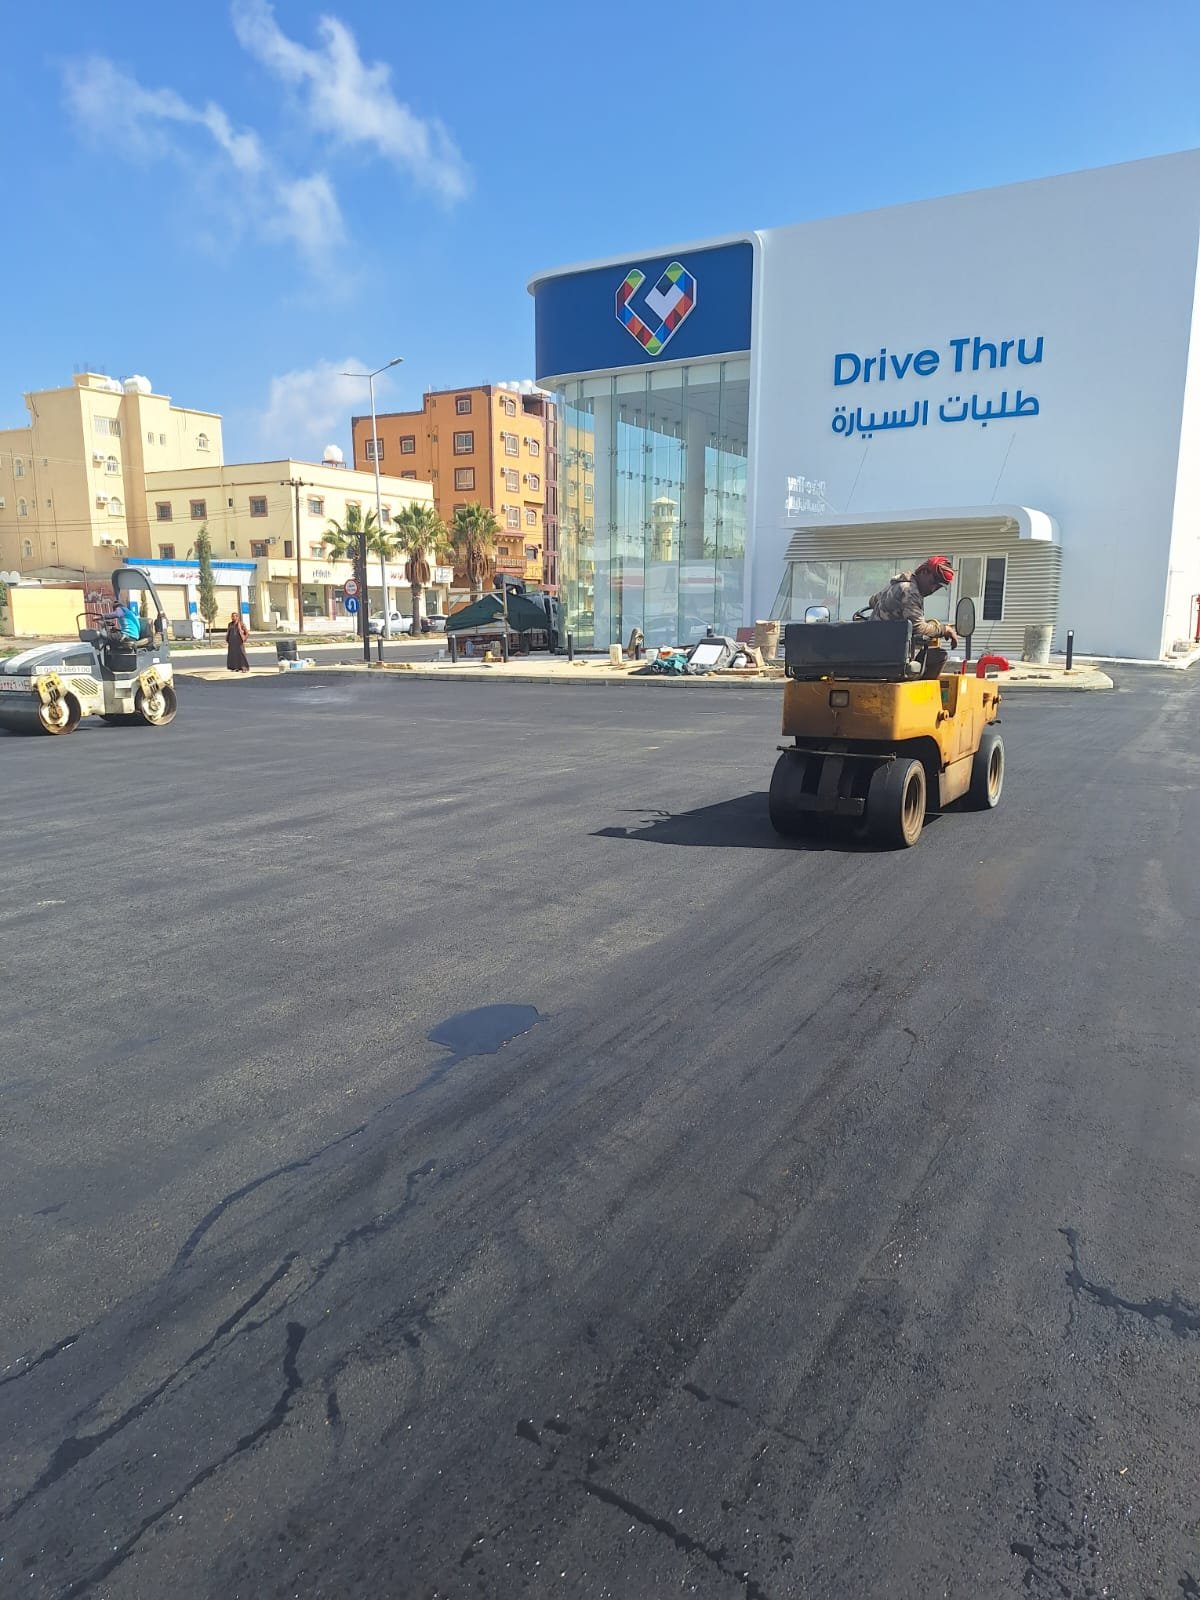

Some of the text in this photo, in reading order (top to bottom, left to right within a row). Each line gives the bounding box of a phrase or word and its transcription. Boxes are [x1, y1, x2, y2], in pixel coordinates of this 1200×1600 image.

[834, 336, 1044, 386] Drive Thru
[831, 390, 1040, 439] طلبات السيارة
